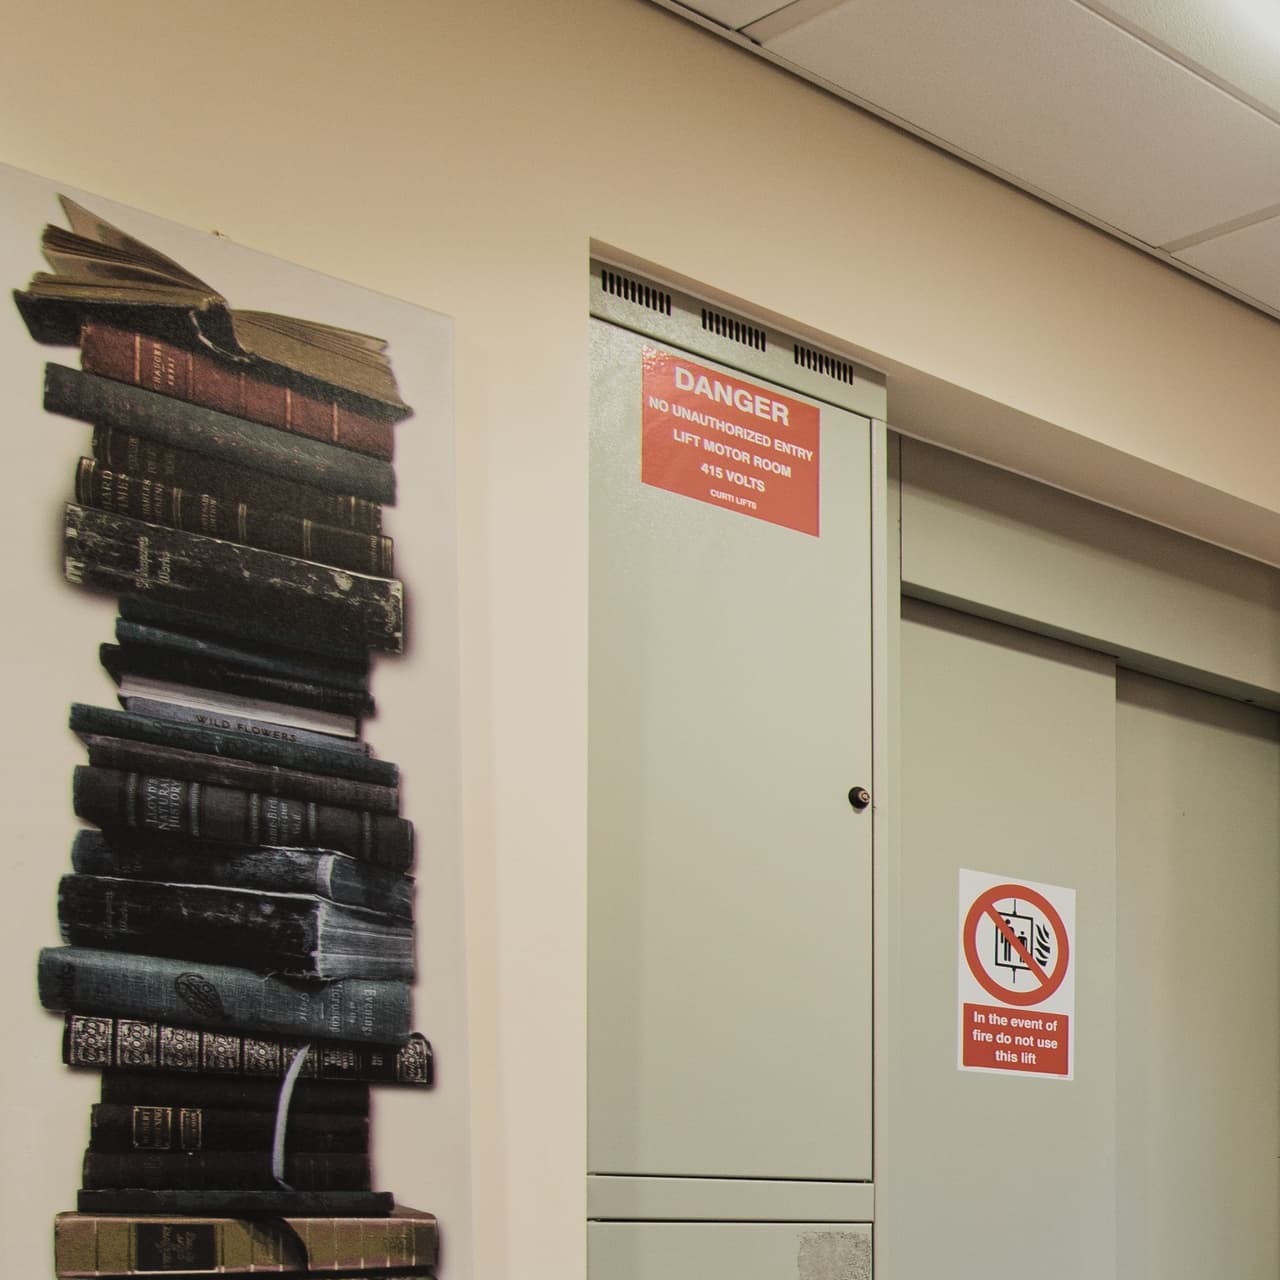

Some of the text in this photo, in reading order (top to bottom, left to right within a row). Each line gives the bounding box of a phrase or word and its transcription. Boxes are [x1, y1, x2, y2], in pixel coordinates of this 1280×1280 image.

[675, 366, 790, 427] DANGER
[649, 395, 814, 462] NO UNAUTHORIZED ENTRY
[673, 428, 792, 478] LIFT MOTOR ROOM
[701, 462, 766, 493] 415 VOLTS
[736, 496, 757, 511] LIFTS
[196, 713, 297, 742] WILD FLOWERS
[328, 982, 343, 1033] Microscop
[972, 1010, 1059, 1032] In the event of
[972, 1029, 1058, 1050] fire do not use
[995, 1050, 1037, 1065] this lift
